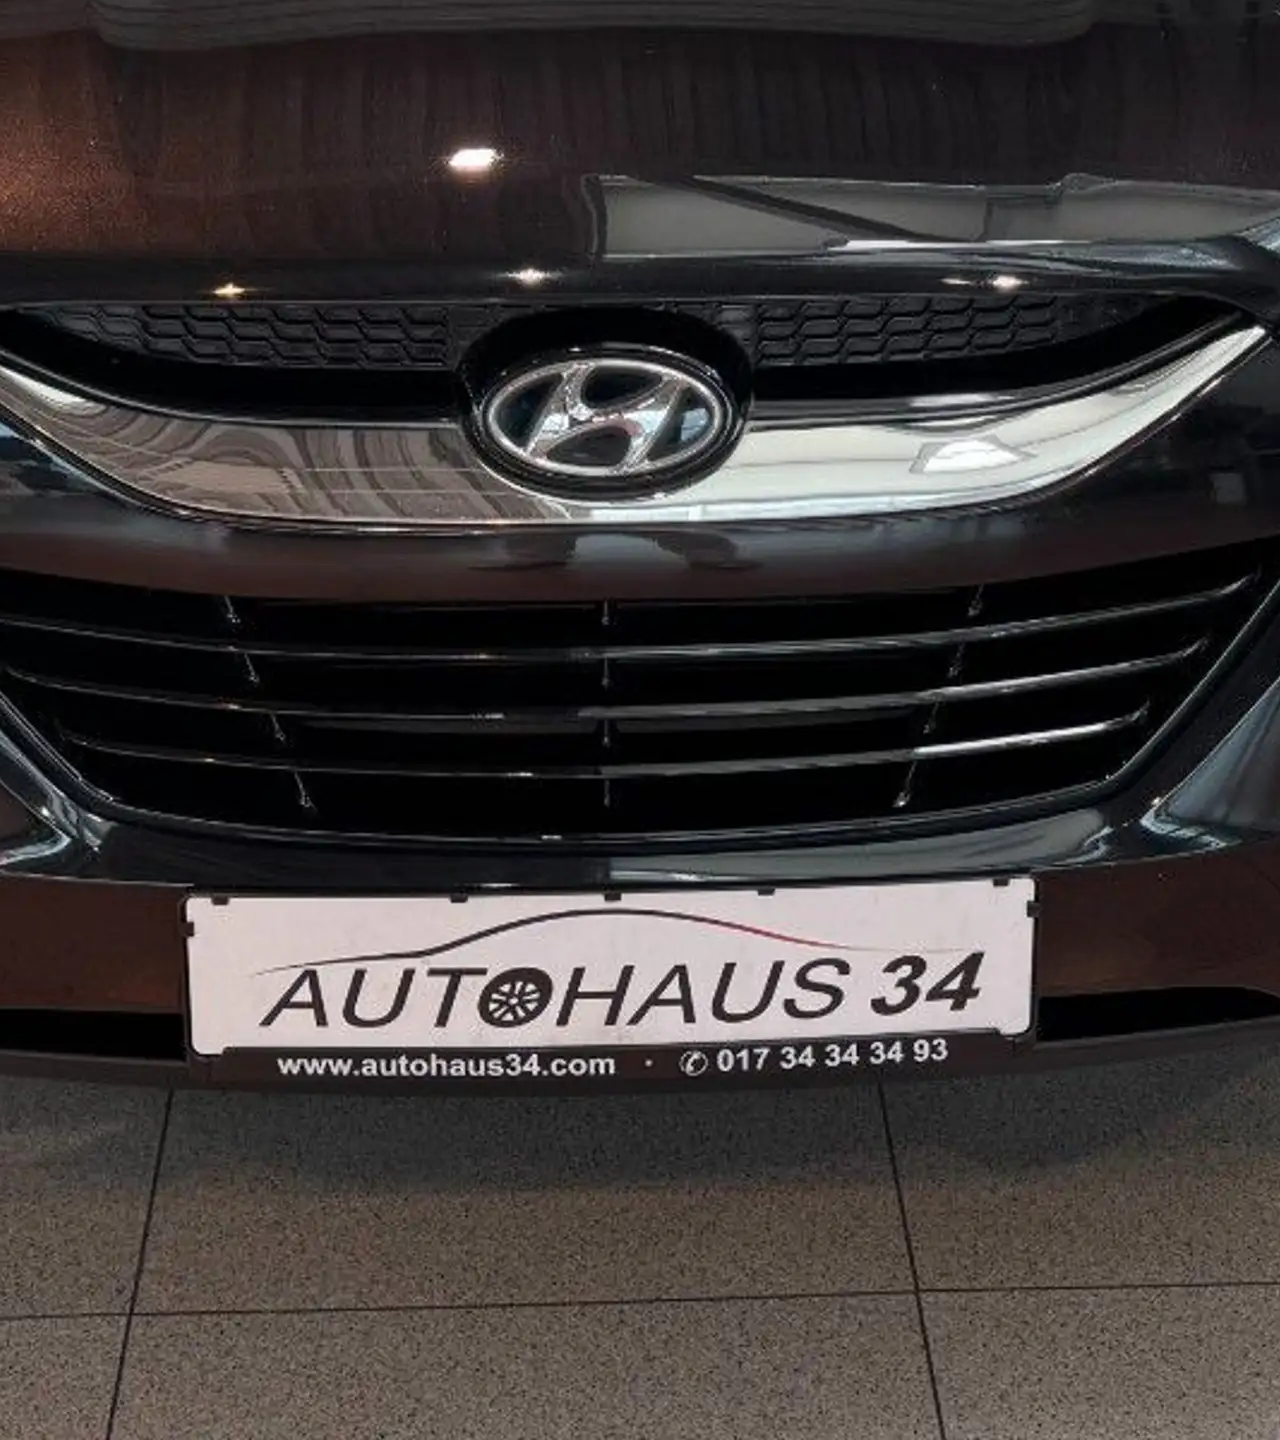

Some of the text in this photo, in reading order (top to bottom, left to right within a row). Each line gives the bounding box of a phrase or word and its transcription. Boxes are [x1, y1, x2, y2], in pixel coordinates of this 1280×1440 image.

[258, 950, 987, 1030] AUTOHAUS 34
[276, 1037, 950, 1078] www.autohaus34.com 017 34 34 34 93
